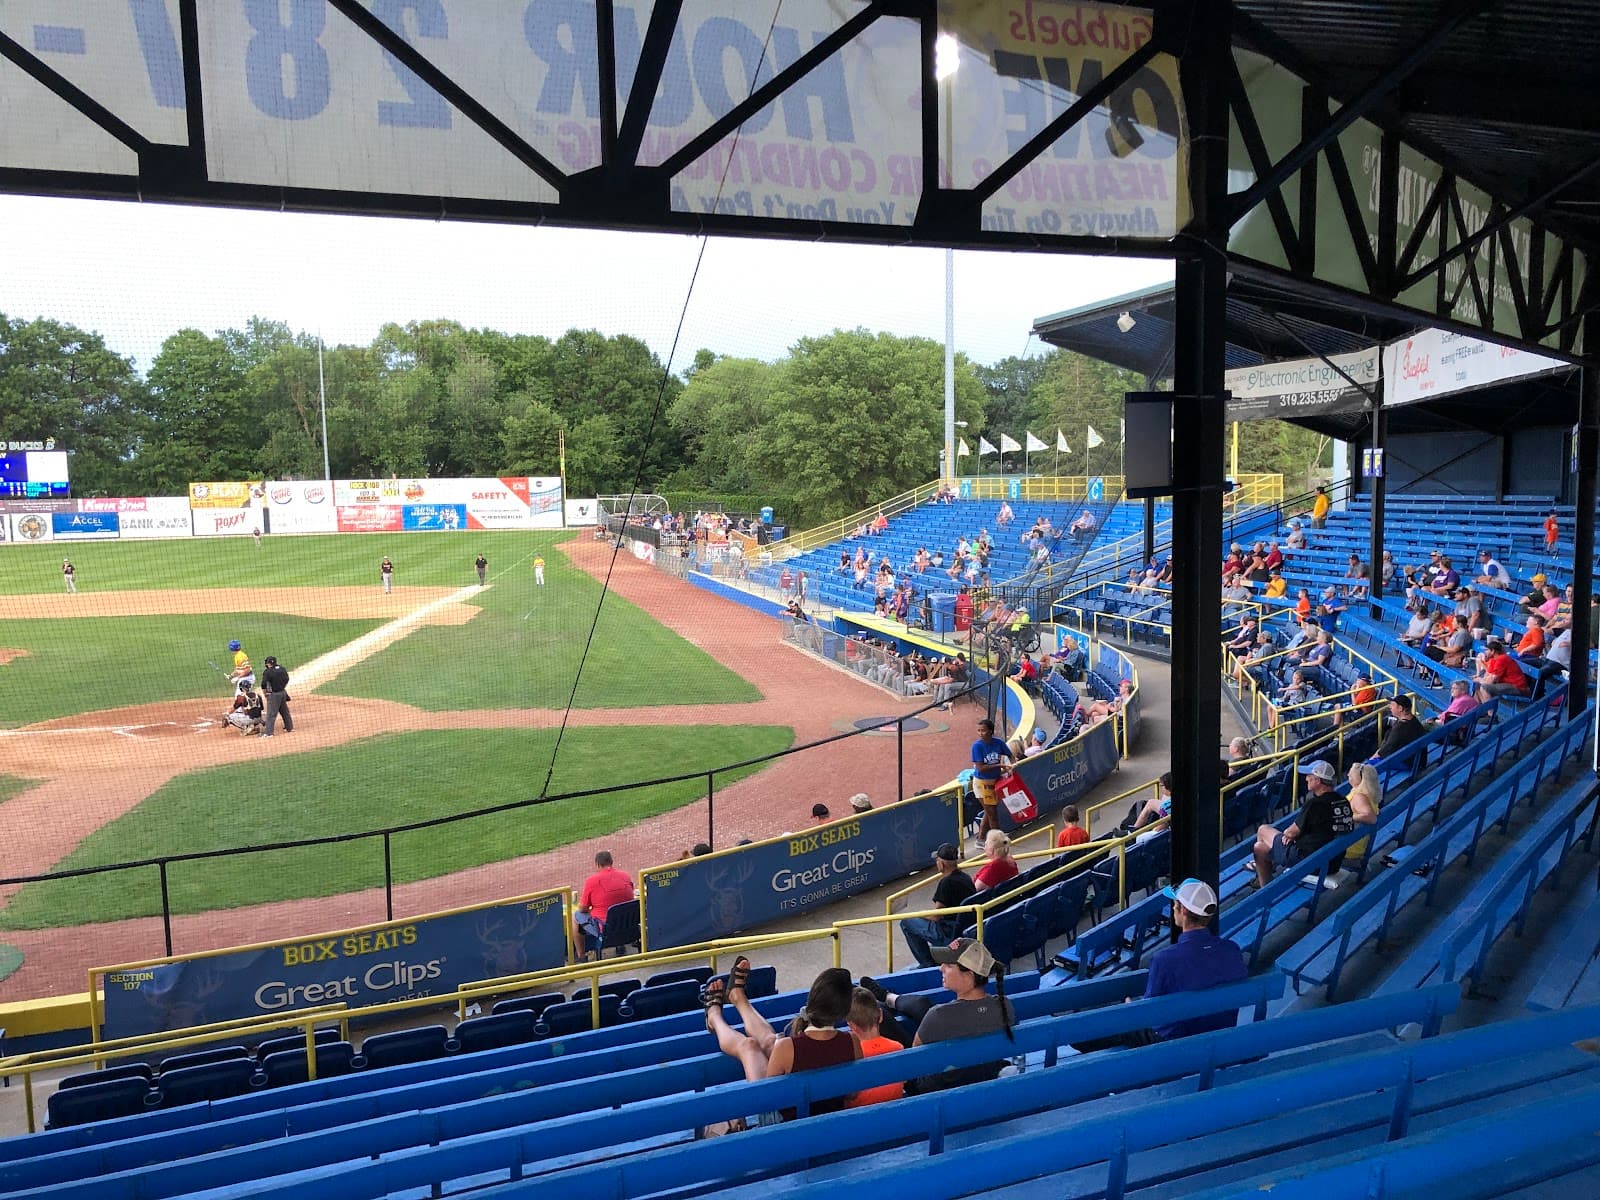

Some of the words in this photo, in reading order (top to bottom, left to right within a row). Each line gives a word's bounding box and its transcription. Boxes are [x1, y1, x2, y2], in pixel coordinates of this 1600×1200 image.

[1259, 368, 1307, 388] Electronic
[1308, 358, 1376, 387] Engineering
[472, 492, 507, 500] SAFETY
[1047, 770, 1076, 791] Great
[789, 835, 819, 857] BOX
[821, 821, 861, 846] SEATS
[650, 870, 679, 881] SECTION
[772, 862, 830, 892] Great
[832, 848, 876, 874] Clips
[527, 895, 560, 911] SECTION
[780, 897, 797, 910] IT'S
[800, 890, 830, 906] GONNA
[831, 883, 843, 894] BE
[844, 872, 869, 890] GREAT
[283, 940, 339, 967] BOX
[343, 925, 418, 958] SEATS
[110, 971, 154, 983] SECTION
[122, 982, 141, 991] 107
[254, 974, 360, 1010] Great
[364, 958, 443, 990] Clips
